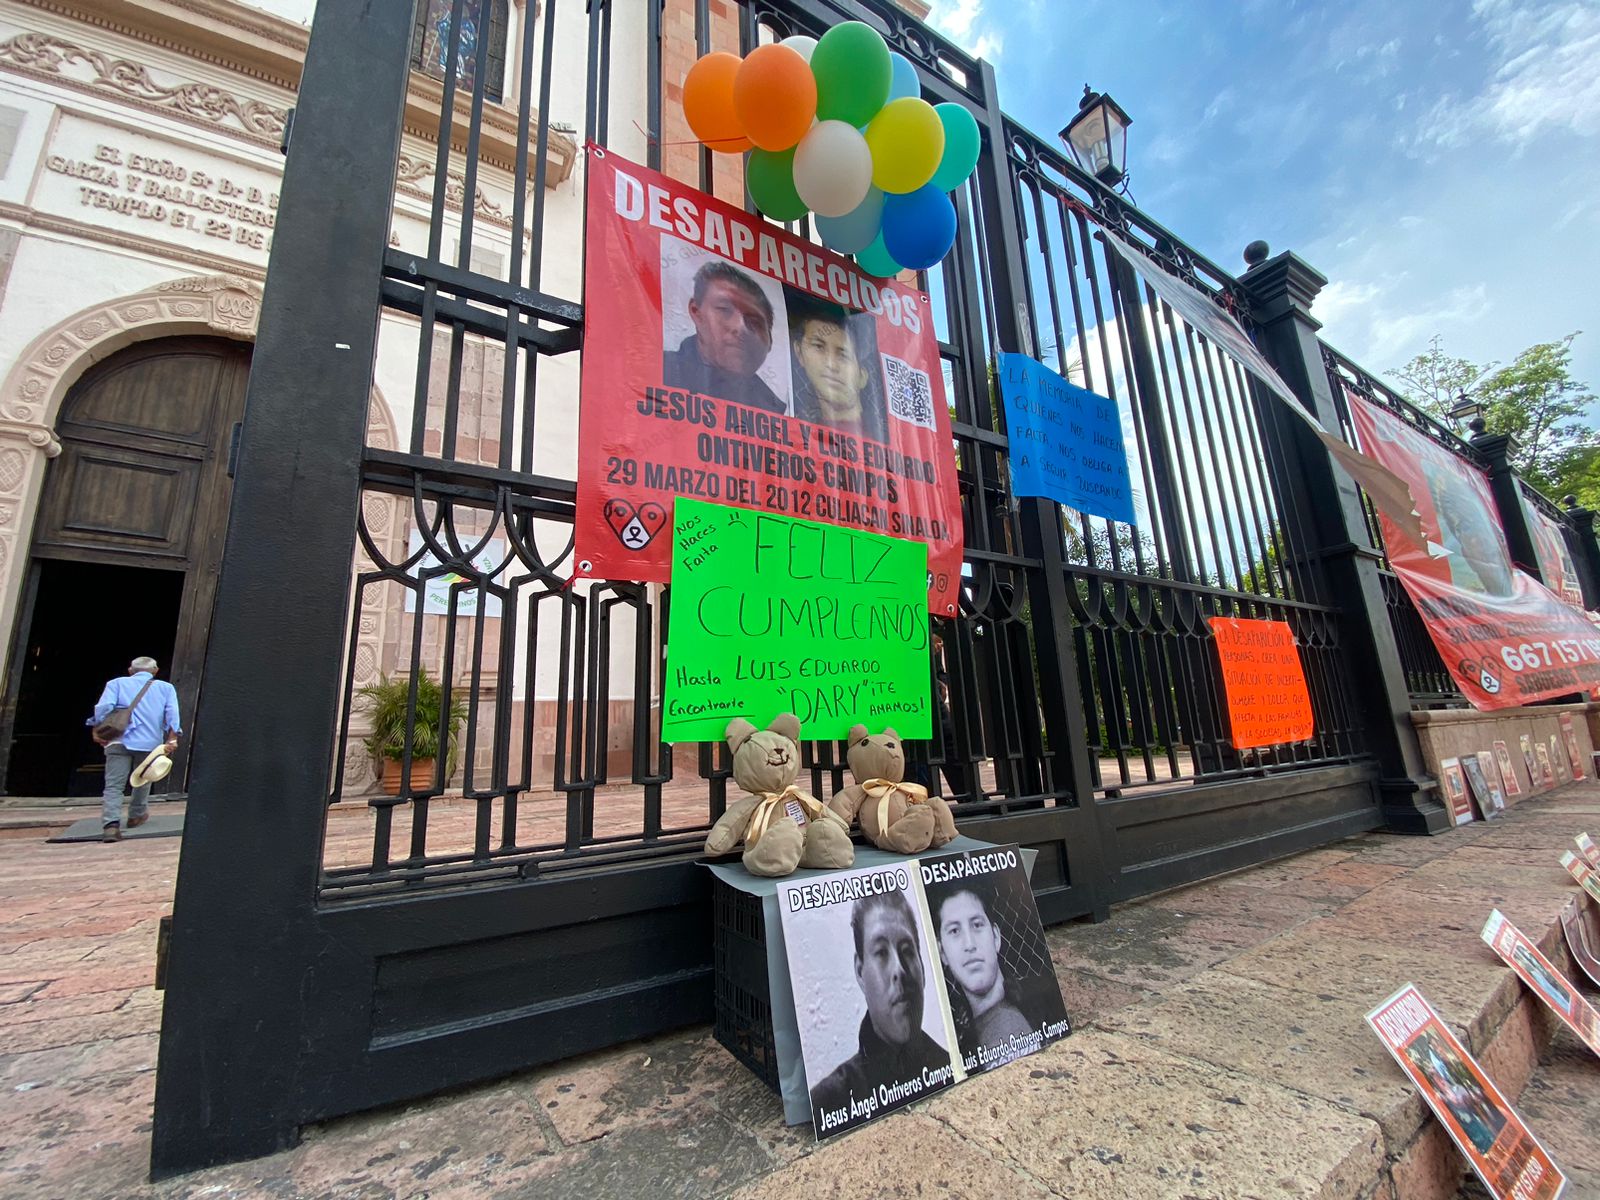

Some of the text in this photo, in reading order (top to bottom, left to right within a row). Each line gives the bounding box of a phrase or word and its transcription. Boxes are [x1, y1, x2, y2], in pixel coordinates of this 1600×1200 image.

[46, 155, 119, 188] GARZA
[126, 174, 142, 192] Y
[94, 144, 123, 166] EL
[219, 178, 243, 198] Dr
[80, 187, 167, 221] TEMPLO
[170, 208, 201, 233] EL
[204, 219, 232, 240] 22
[235, 227, 264, 249] DE
[614, 168, 922, 335] DESAPARECIDOS
[1009, 367, 1111, 423] LA MEMORIA DE
[725, 404, 793, 447] ANGEL
[800, 423, 812, 449] Y
[818, 428, 858, 463] LUIS
[863, 441, 936, 485] EDUARDO
[1015, 395, 1124, 452] QUIENES NOS HACEN
[697, 431, 817, 483] ONTIVEROS
[823, 461, 899, 504] CAMPOS
[1020, 455, 1031, 469] A
[1040, 457, 1068, 481] SEGUIR
[1058, 443, 1077, 462] NOS
[1081, 455, 1113, 474] OBLIGA
[606, 456, 951, 542] 29 MARZO DEL 2012 CULIACAN SINALOA
[756, 515, 898, 585] FELIZ
[1219, 629, 1231, 646] LA
[1500, 641, 1552, 672] 667
[676, 665, 721, 688] Hasta
[736, 655, 880, 681] LUIS EDUARDO
[1264, 673, 1273, 686] DE
[669, 697, 744, 716] Encontrarte
[1293, 694, 1304, 704] QUE
[921, 850, 1018, 885] DESAPARECIDO
[788, 868, 909, 912] DESAPARECIDO
[960, 1051, 978, 1071] Luis
[977, 1038, 1009, 1066] Eduardo
[1009, 1028, 1044, 1052] Ontiveros
[1042, 1018, 1069, 1038] Campos
[850, 1088, 880, 1121] Ángel
[880, 1075, 923, 1108] Ontiveros
[922, 1062, 954, 1085] Campos
